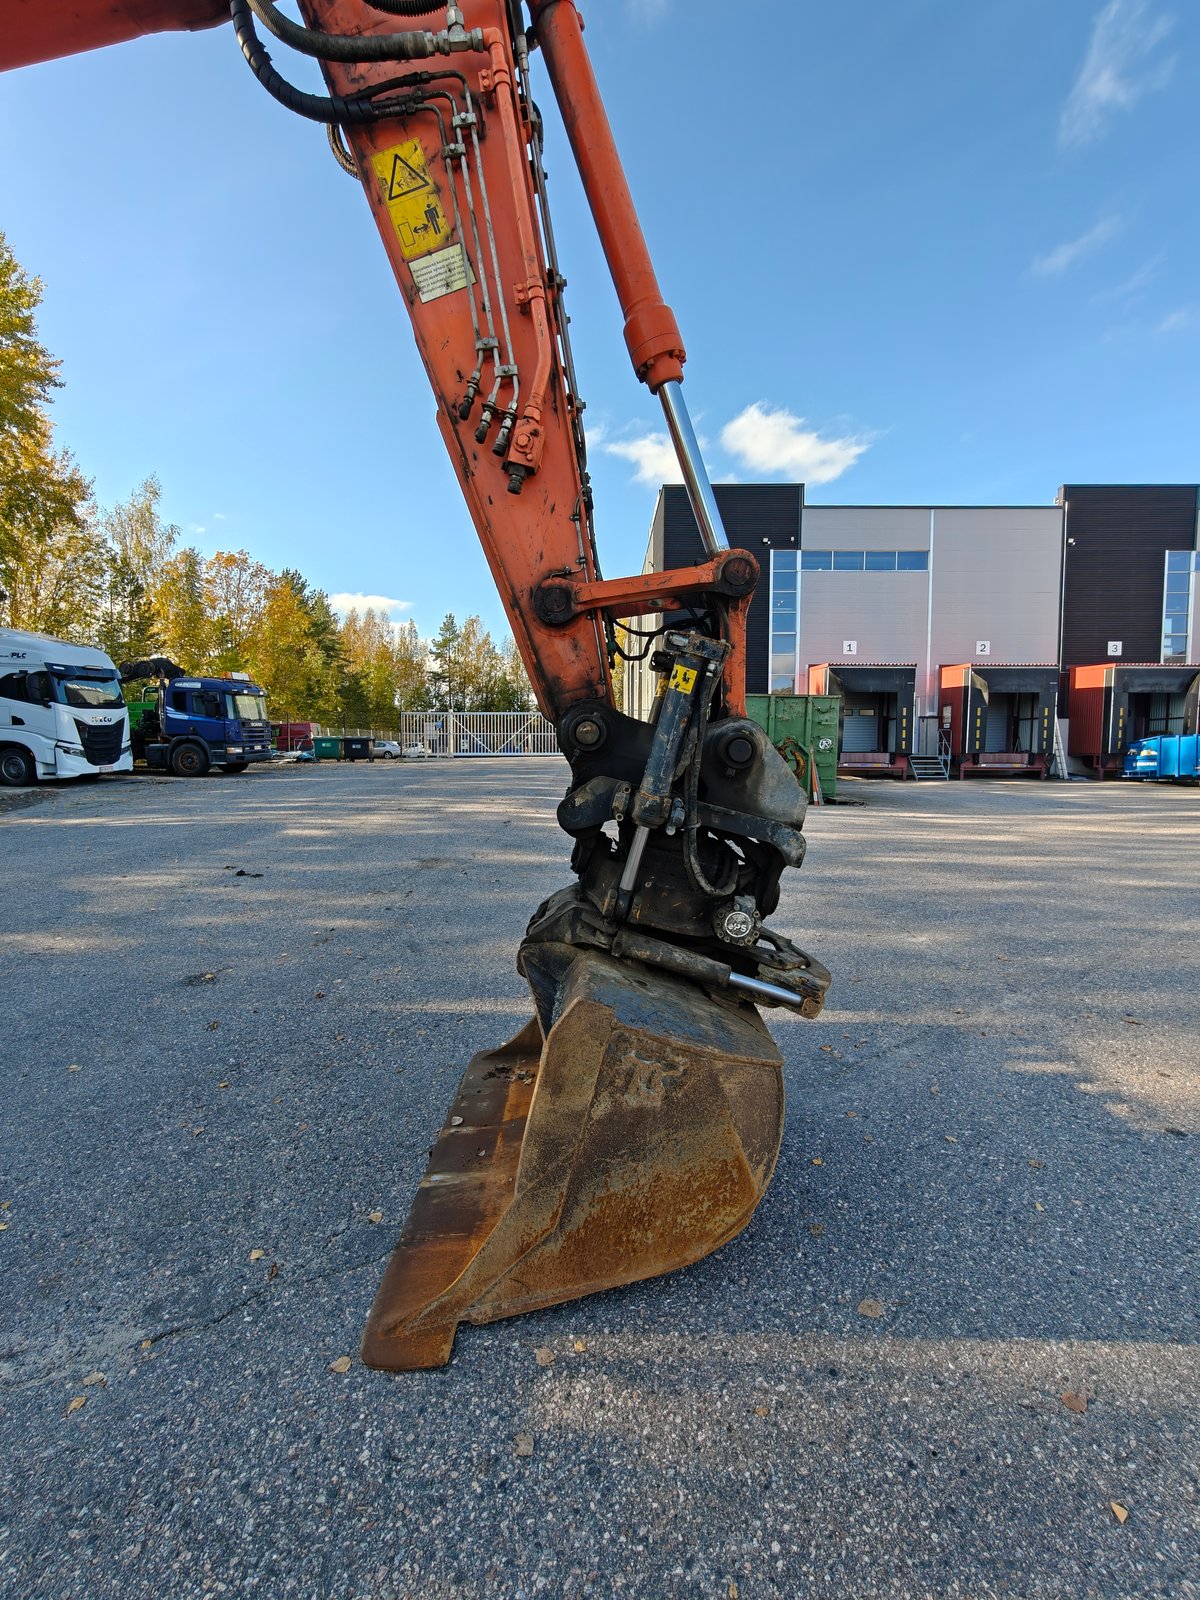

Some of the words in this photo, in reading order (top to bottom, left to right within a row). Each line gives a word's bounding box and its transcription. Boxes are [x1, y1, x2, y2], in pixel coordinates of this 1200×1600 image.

[846, 644, 852, 652] 1
[980, 644, 986, 652] 2
[1112, 644, 1118, 652] 3
